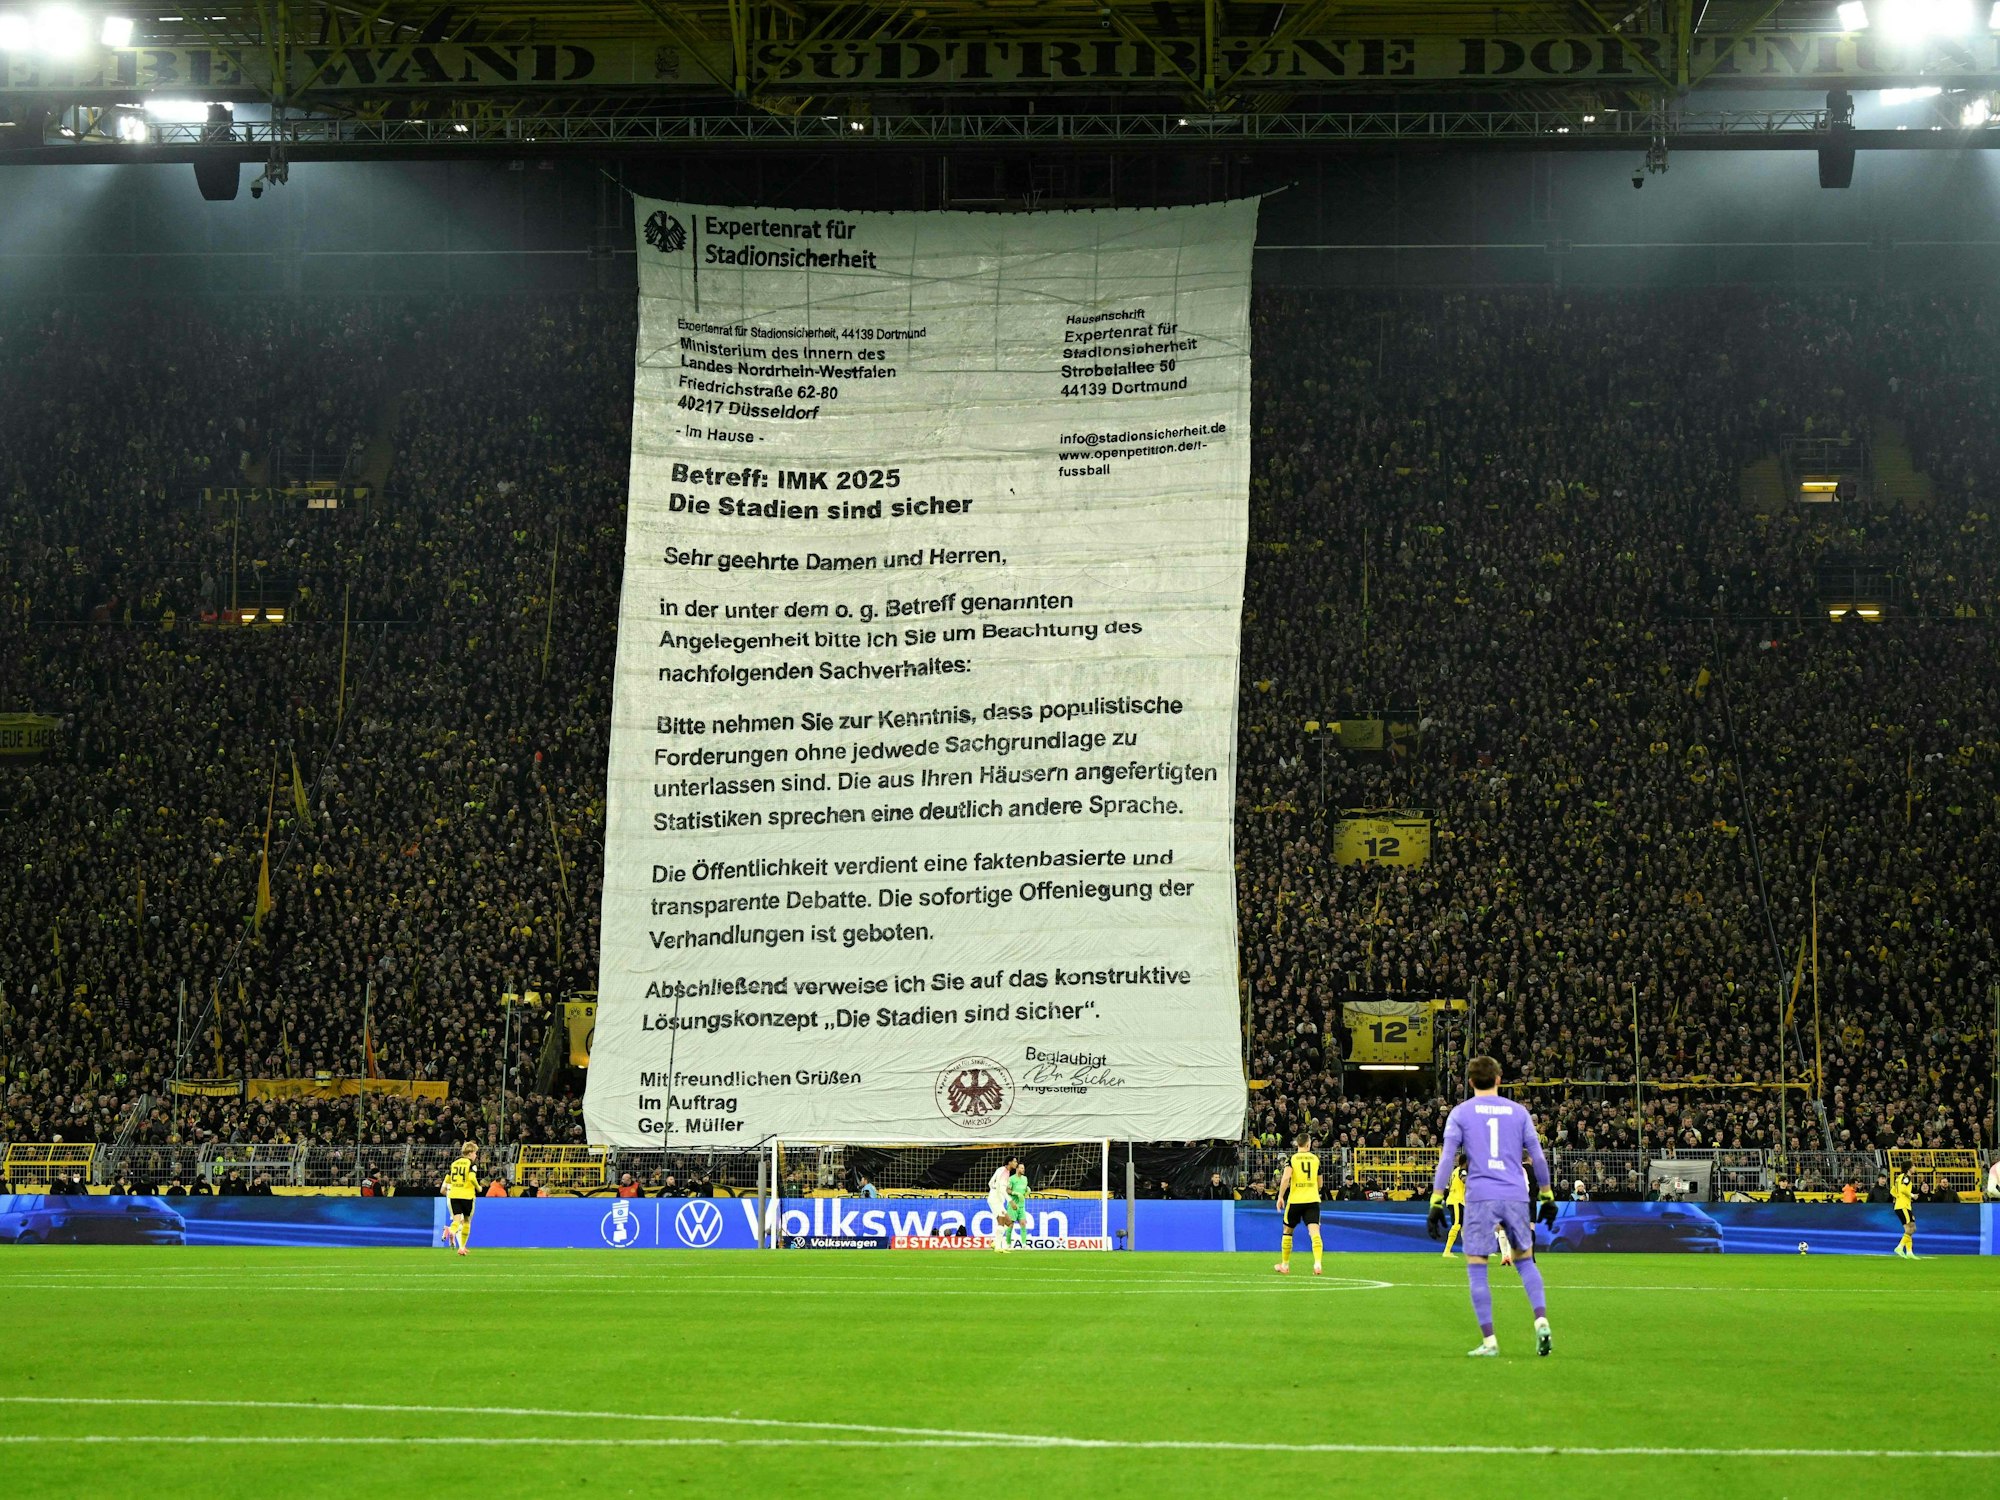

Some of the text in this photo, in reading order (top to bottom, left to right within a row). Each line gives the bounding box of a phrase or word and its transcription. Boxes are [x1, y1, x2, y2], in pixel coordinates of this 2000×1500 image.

[303, 45, 596, 84] WAND
[757, 38, 1416, 81] SÜDTRIBÜNE
[706, 216, 856, 239] Expertenrat für
[705, 244, 876, 269] Stadionsicherheit
[735, 326, 748, 336] für
[751, 327, 838, 340] Stadionsicherheit,
[842, 329, 873, 339] 44139
[877, 327, 926, 339] Dortmund
[1065, 323, 1178, 345] Expertenrat für
[679, 337, 885, 360] Ministerium des Innern des
[1063, 338, 1197, 358] Stadionsicherheit
[681, 354, 896, 379] Landes Nordrhein-Westfalen
[1061, 359, 1176, 378] Strobelallee 50
[679, 375, 838, 399] Friedrichstraße 62-80
[1061, 377, 1187, 397] 44139 Dortmund
[678, 395, 820, 419] 40217 Düsseldorf
[686, 425, 701, 438] Im
[708, 428, 753, 442] Hause
[1061, 423, 1225, 447] info@stadionsicherheit.de
[672, 463, 900, 490] Betreff: IMK 2025
[1059, 464, 1109, 476] fussball
[669, 493, 973, 519] Die Stadien sind sicher
[664, 547, 1006, 572] Sehr geehrte Damen und Herren,
[660, 593, 1072, 623] in der unter dem o. g. Betreff genannten
[659, 621, 1142, 653] Angelegenheit bitte ich Sie um Beachtung des
[659, 658, 970, 686] nachfolgenden Sachverhaltes:
[657, 696, 1183, 734] Bitte nehmen Sie zur Kenntnis, dass populistische
[0, 730, 23, 748] EUE
[655, 732, 1136, 767] Forderungen ohne jedwede Sachgrundlage zu
[655, 761, 1216, 797] unterlassen sind. Die aus Ihren Häusern angefertigten
[654, 795, 1183, 830] Statistiken sprechen eine deutlich andere Sprache.
[1365, 837, 1400, 857] 12
[653, 850, 1172, 883] Die Öffentlichkeit verdient eine faktenbasierte und
[651, 879, 1194, 918] transparente Debatte. Die sofortige Offenlegung der
[649, 924, 933, 949] Verhandlungen ist geboten.
[645, 966, 1190, 998] Abschließend verweise ich Sie auf das konstruktive
[643, 1001, 1099, 1033] Lösungskonzept „Die Stadien sind sicher“.
[1369, 1021, 1408, 1043] 12
[1026, 1046, 1106, 1068] Beglaubigt
[641, 1070, 861, 1086] Mit freundlichen Grüßen
[639, 1095, 737, 1113] Im Auftrag
[638, 1118, 744, 1133] Gez. Müller
[1486, 1117, 1499, 1158] 1
[451, 1166, 467, 1183] 24
[1301, 1161, 1312, 1179] 4
[811, 1237, 877, 1248] Volkswagen
[909, 1237, 983, 1248] STRAUSS
